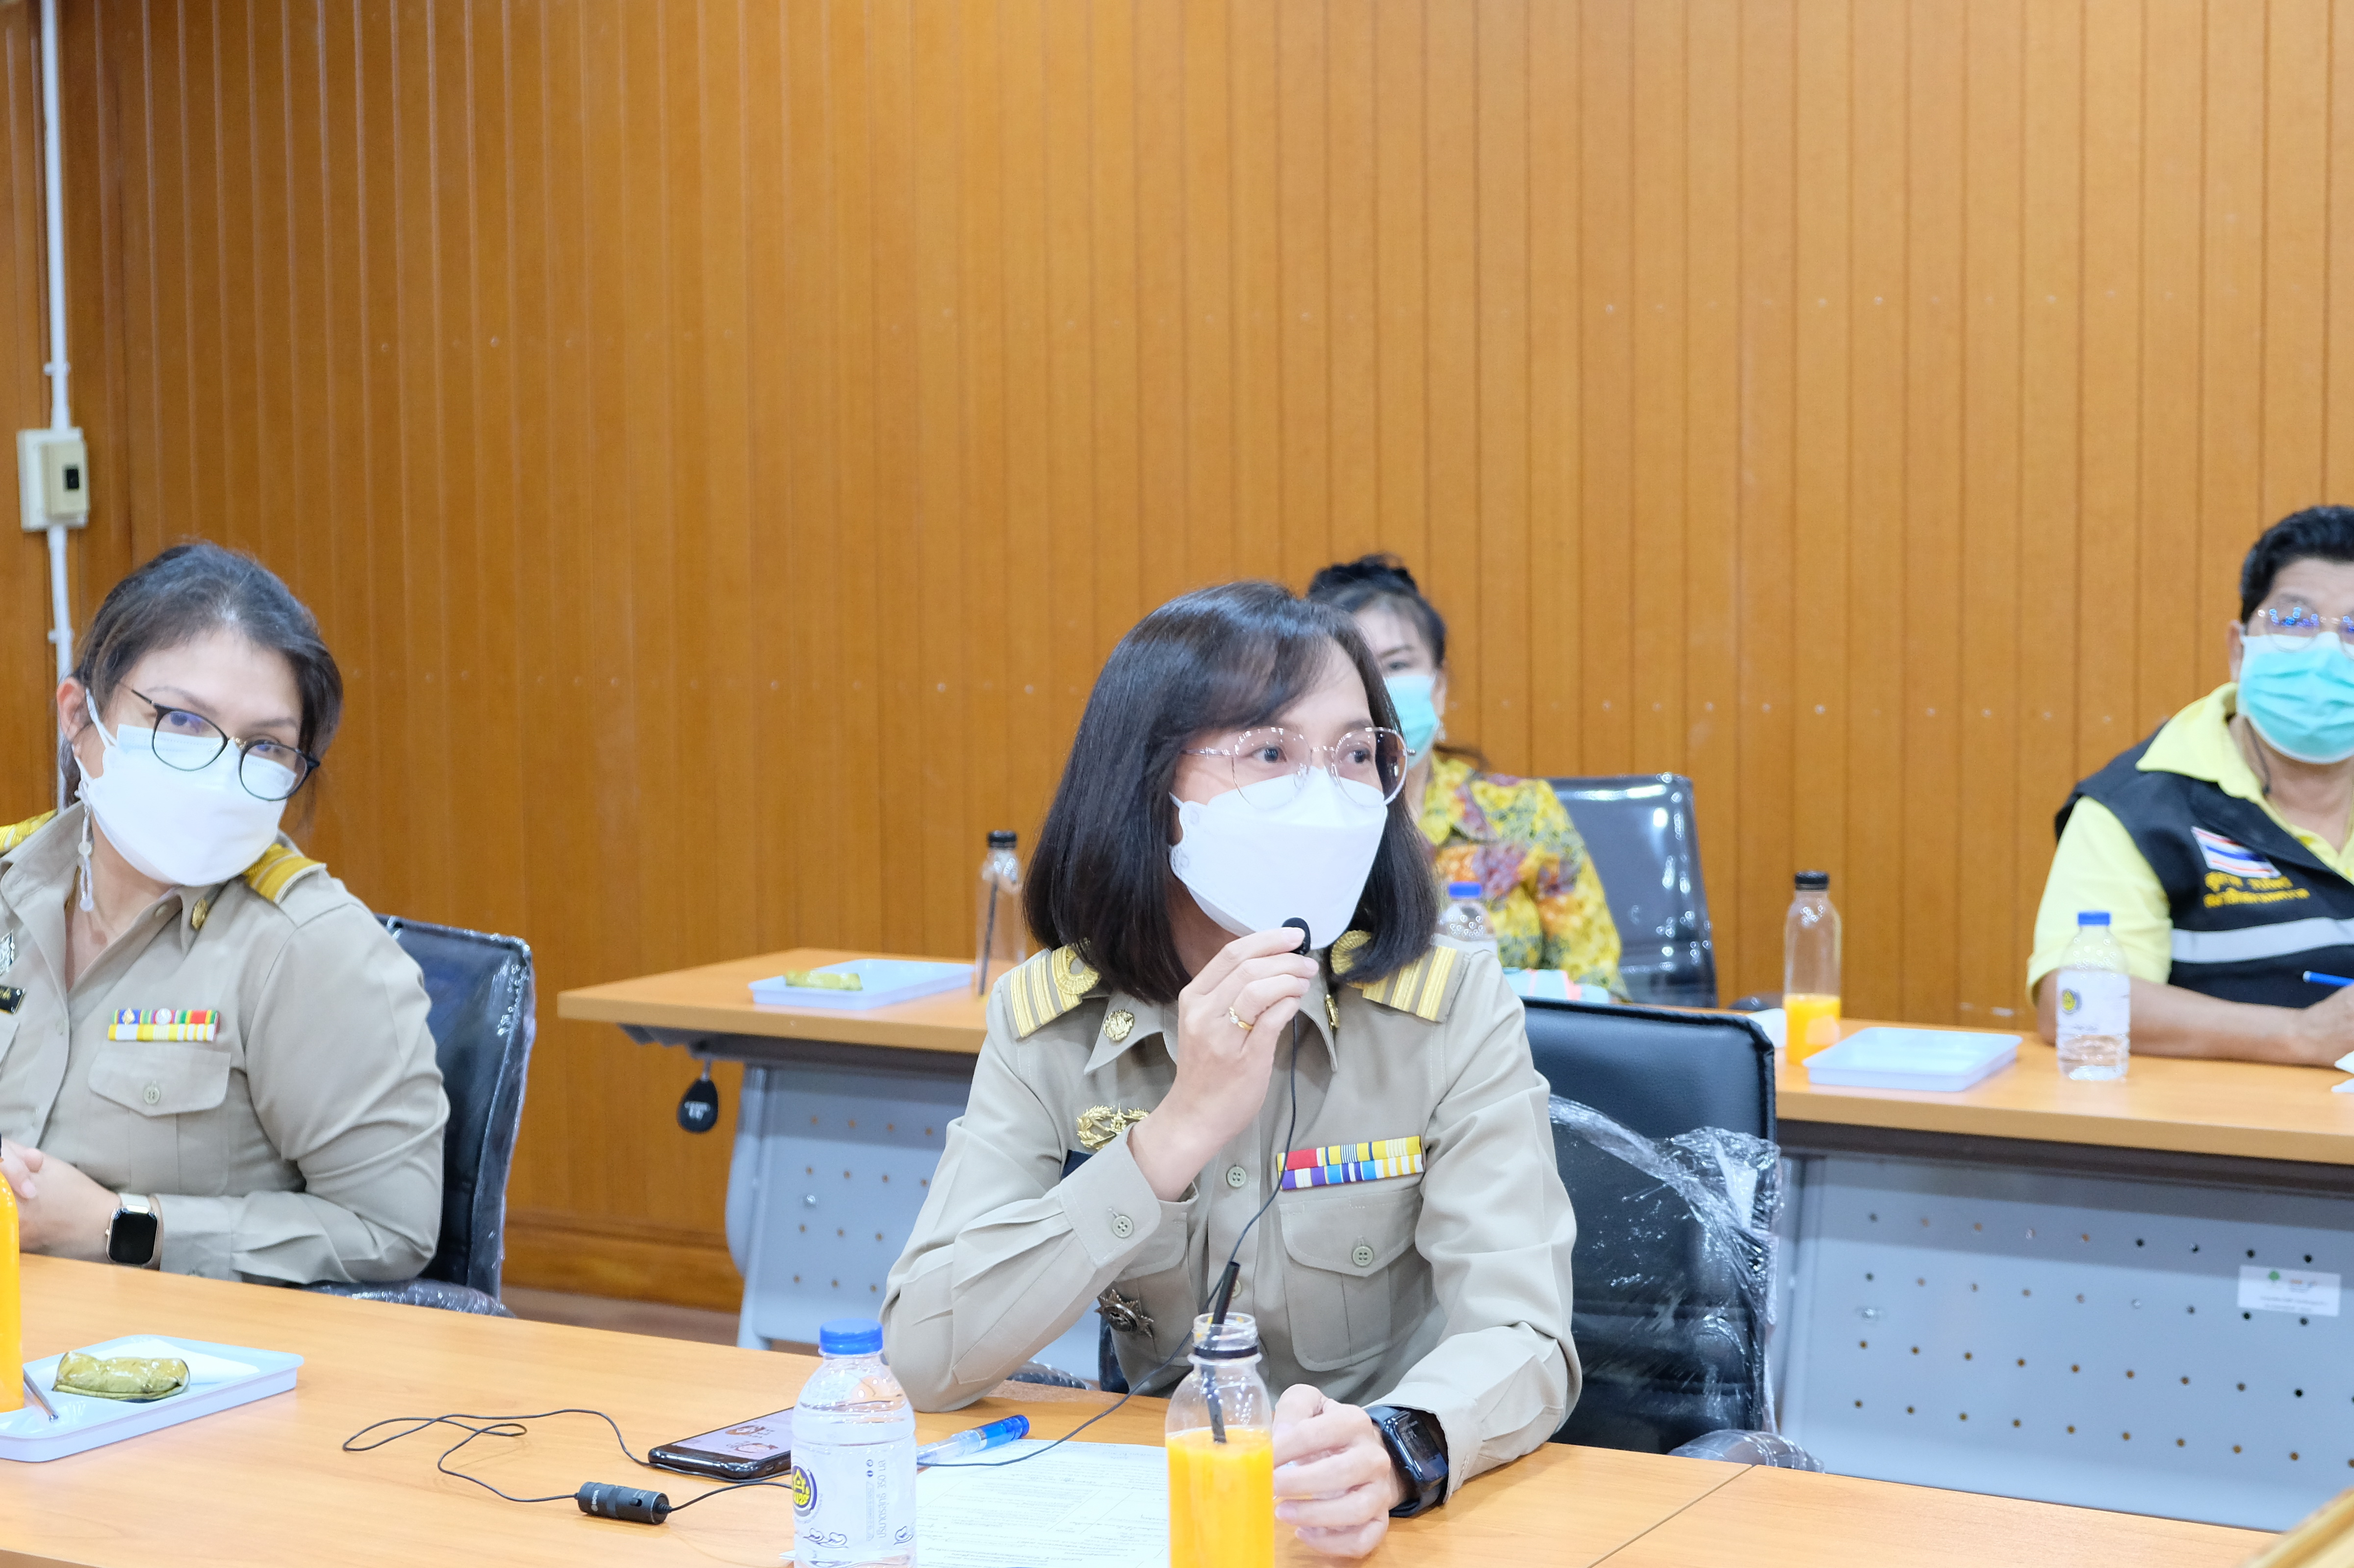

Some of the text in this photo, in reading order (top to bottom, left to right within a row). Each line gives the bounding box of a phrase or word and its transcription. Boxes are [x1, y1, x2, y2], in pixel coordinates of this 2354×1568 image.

[877, 1475, 886, 1489] 350
[591, 1490, 600, 1504] BOYA
[876, 1493, 889, 1539] ปริมาตรสุทธิ
